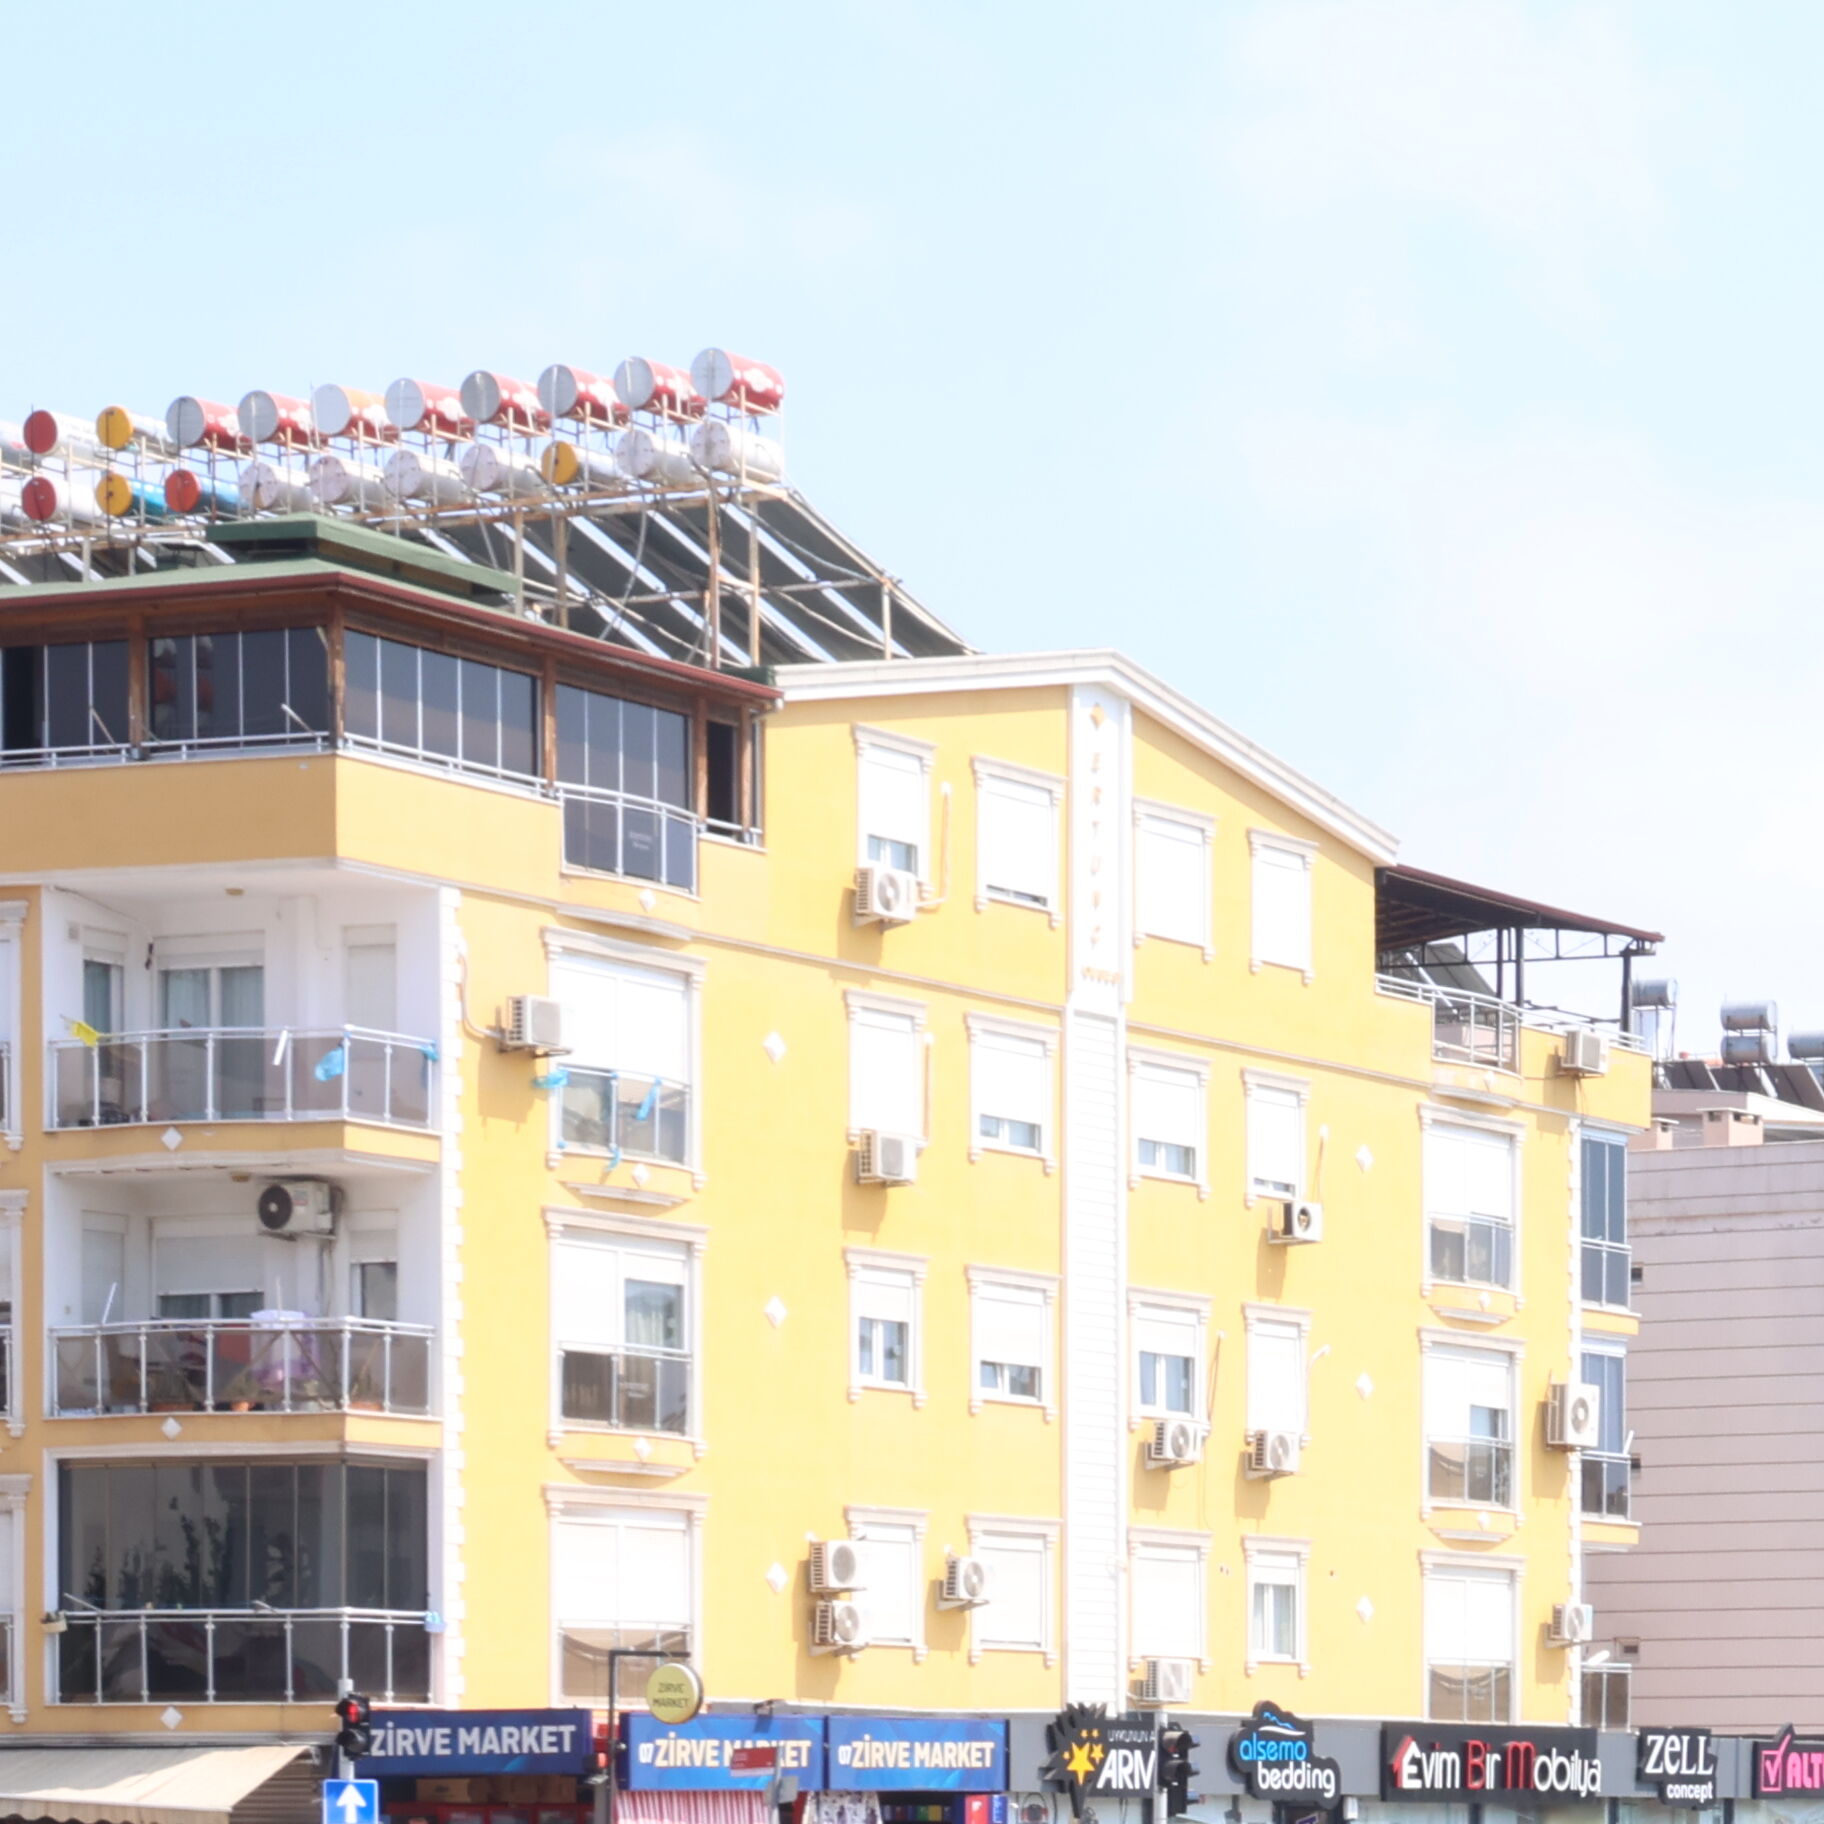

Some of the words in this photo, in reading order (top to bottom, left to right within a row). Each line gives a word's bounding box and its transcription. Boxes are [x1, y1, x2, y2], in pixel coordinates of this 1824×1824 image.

[370, 1721, 453, 1757] ZİRVE
[457, 1725, 576, 1754] MARKET
[654, 1731, 720, 1768] ZİRVE
[852, 1733, 911, 1768] ZİRVE
[914, 1741, 995, 1768] MARKET
[1239, 1732, 1307, 1761] alsemo
[1257, 1761, 1336, 1798] bedding
[1402, 1741, 1461, 1789] Evim
[1465, 1740, 1501, 1788] Bir
[1504, 1741, 1601, 1798] Mobilya
[1667, 1781, 1713, 1801] concept
